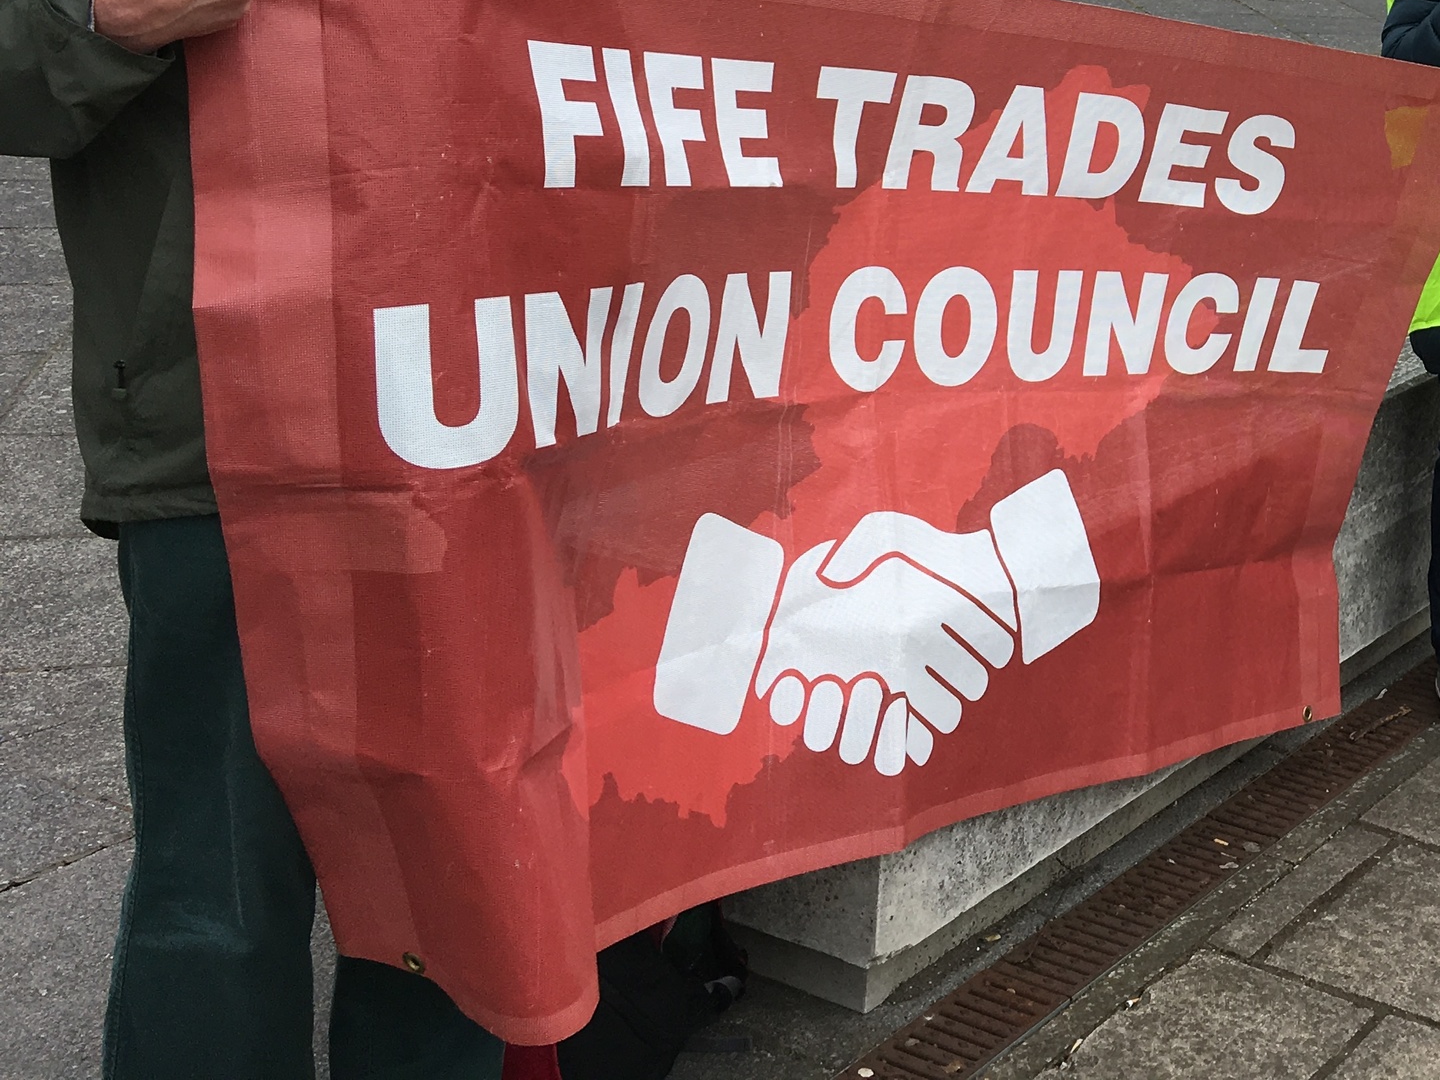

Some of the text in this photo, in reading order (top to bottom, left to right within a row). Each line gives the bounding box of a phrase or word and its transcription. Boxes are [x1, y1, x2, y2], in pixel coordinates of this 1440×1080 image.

[527, 39, 1297, 216] FIFE TRADES
[372, 266, 1330, 469] UNION COUNCIL
